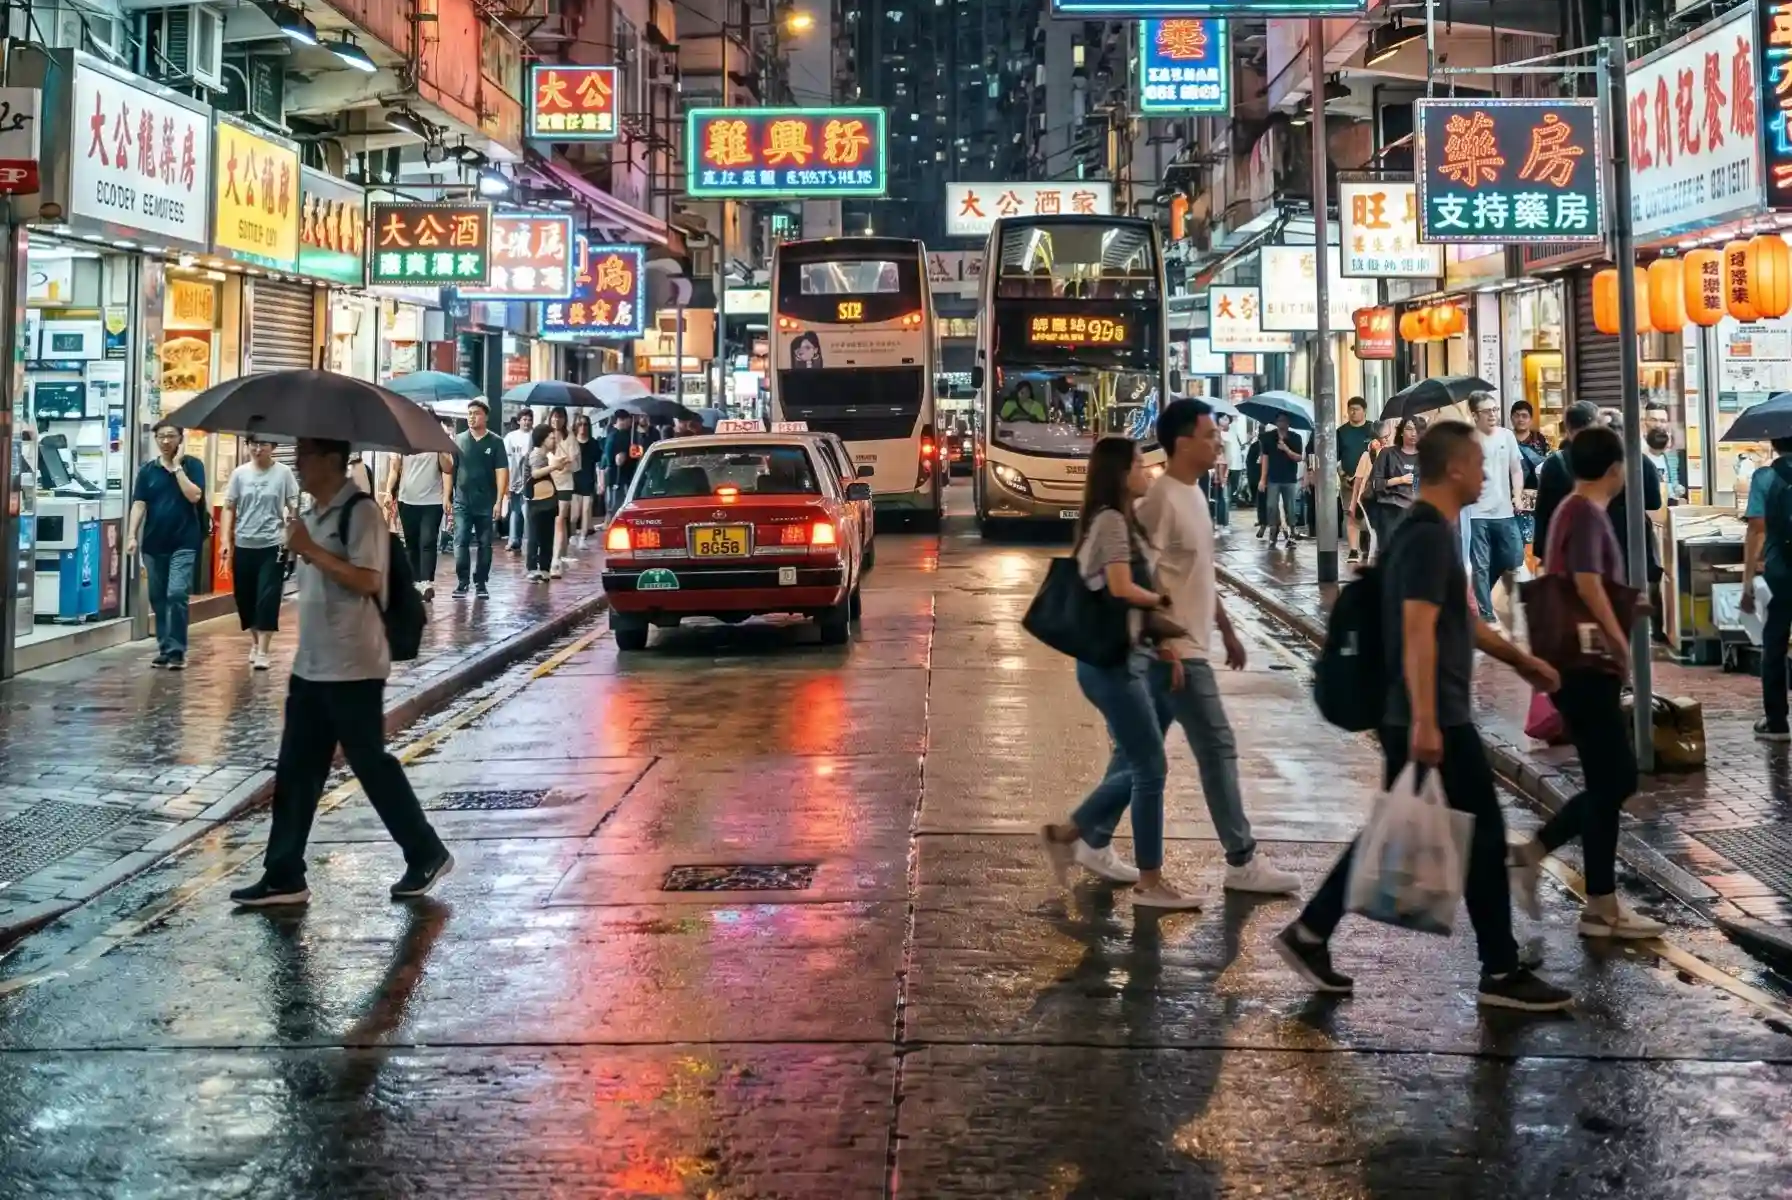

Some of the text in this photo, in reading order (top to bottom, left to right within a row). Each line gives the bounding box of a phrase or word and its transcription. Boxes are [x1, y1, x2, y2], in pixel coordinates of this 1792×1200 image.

[538, 70, 613, 109] 大公
[1438, 112, 1584, 188] 藥房
[379, 212, 480, 248] 大公酒
[1433, 192, 1590, 230] 支持藥房
